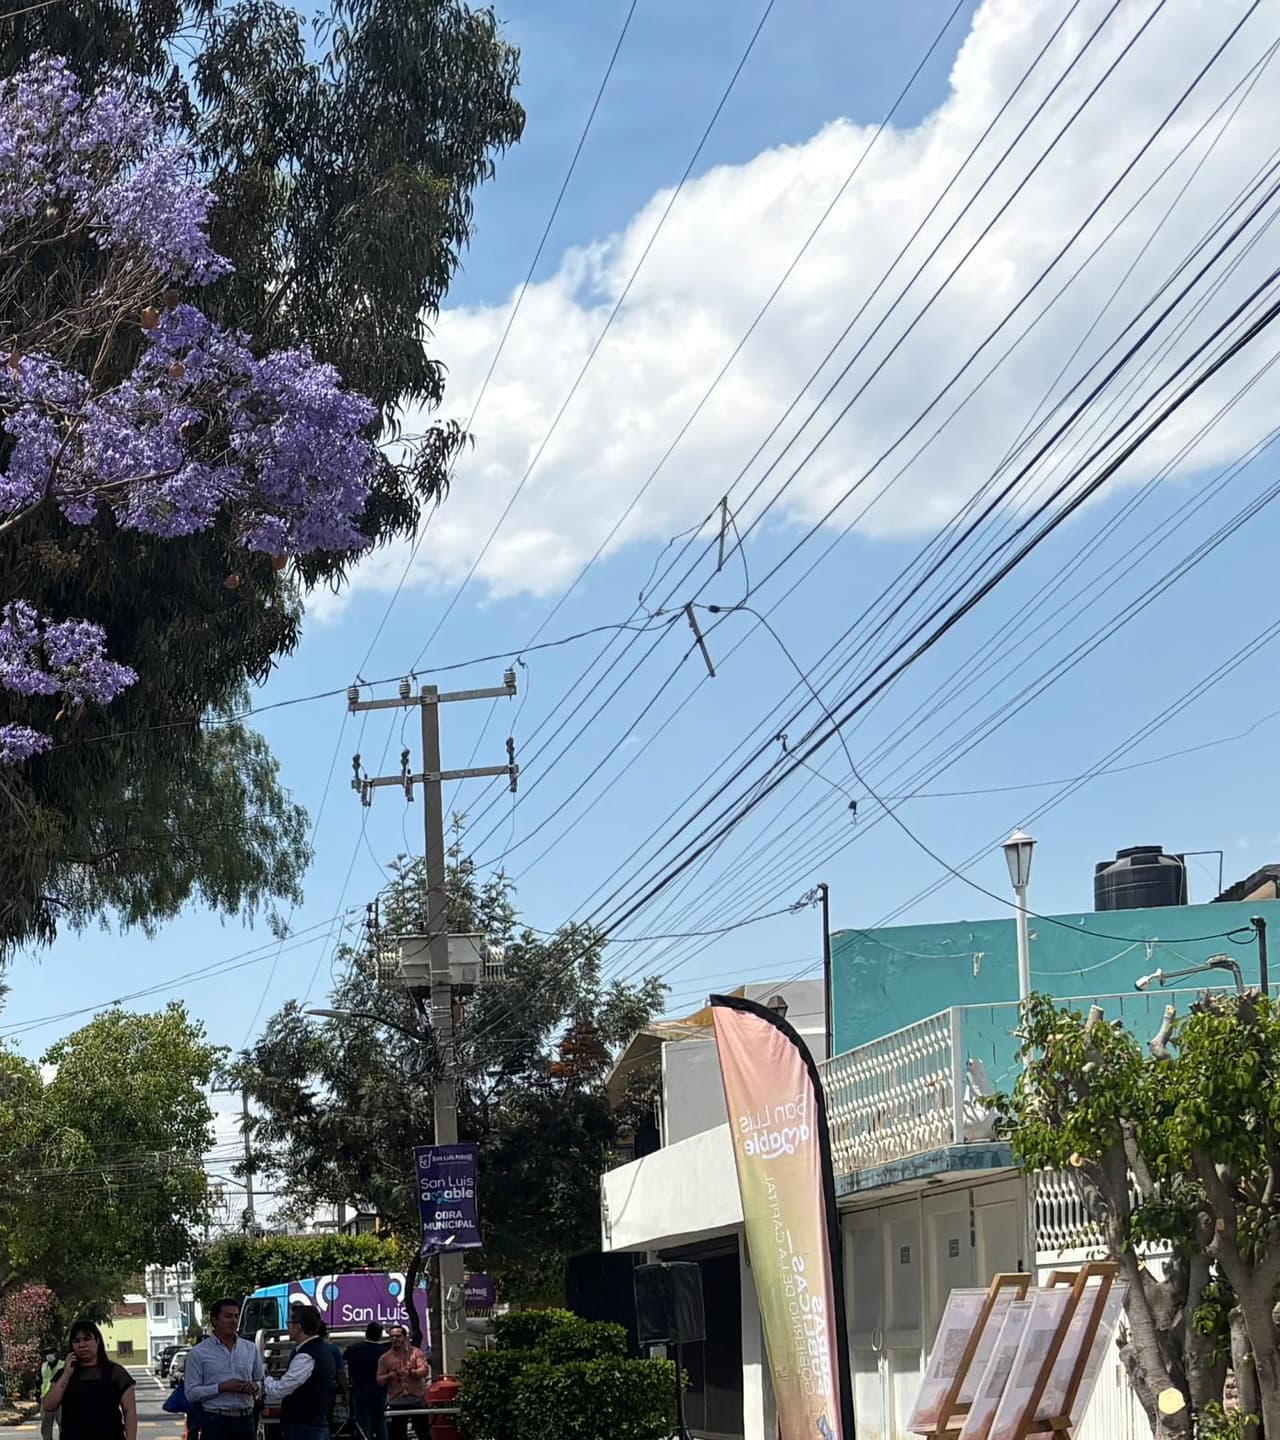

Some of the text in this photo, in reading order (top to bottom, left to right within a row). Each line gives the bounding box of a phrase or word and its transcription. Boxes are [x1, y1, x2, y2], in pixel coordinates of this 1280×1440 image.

[420, 1175, 474, 1190] San Luis
[435, 1210, 463, 1220] OBRA
[423, 1220, 475, 1231] MUNICIPAL
[342, 1303, 410, 1322] San Luis
